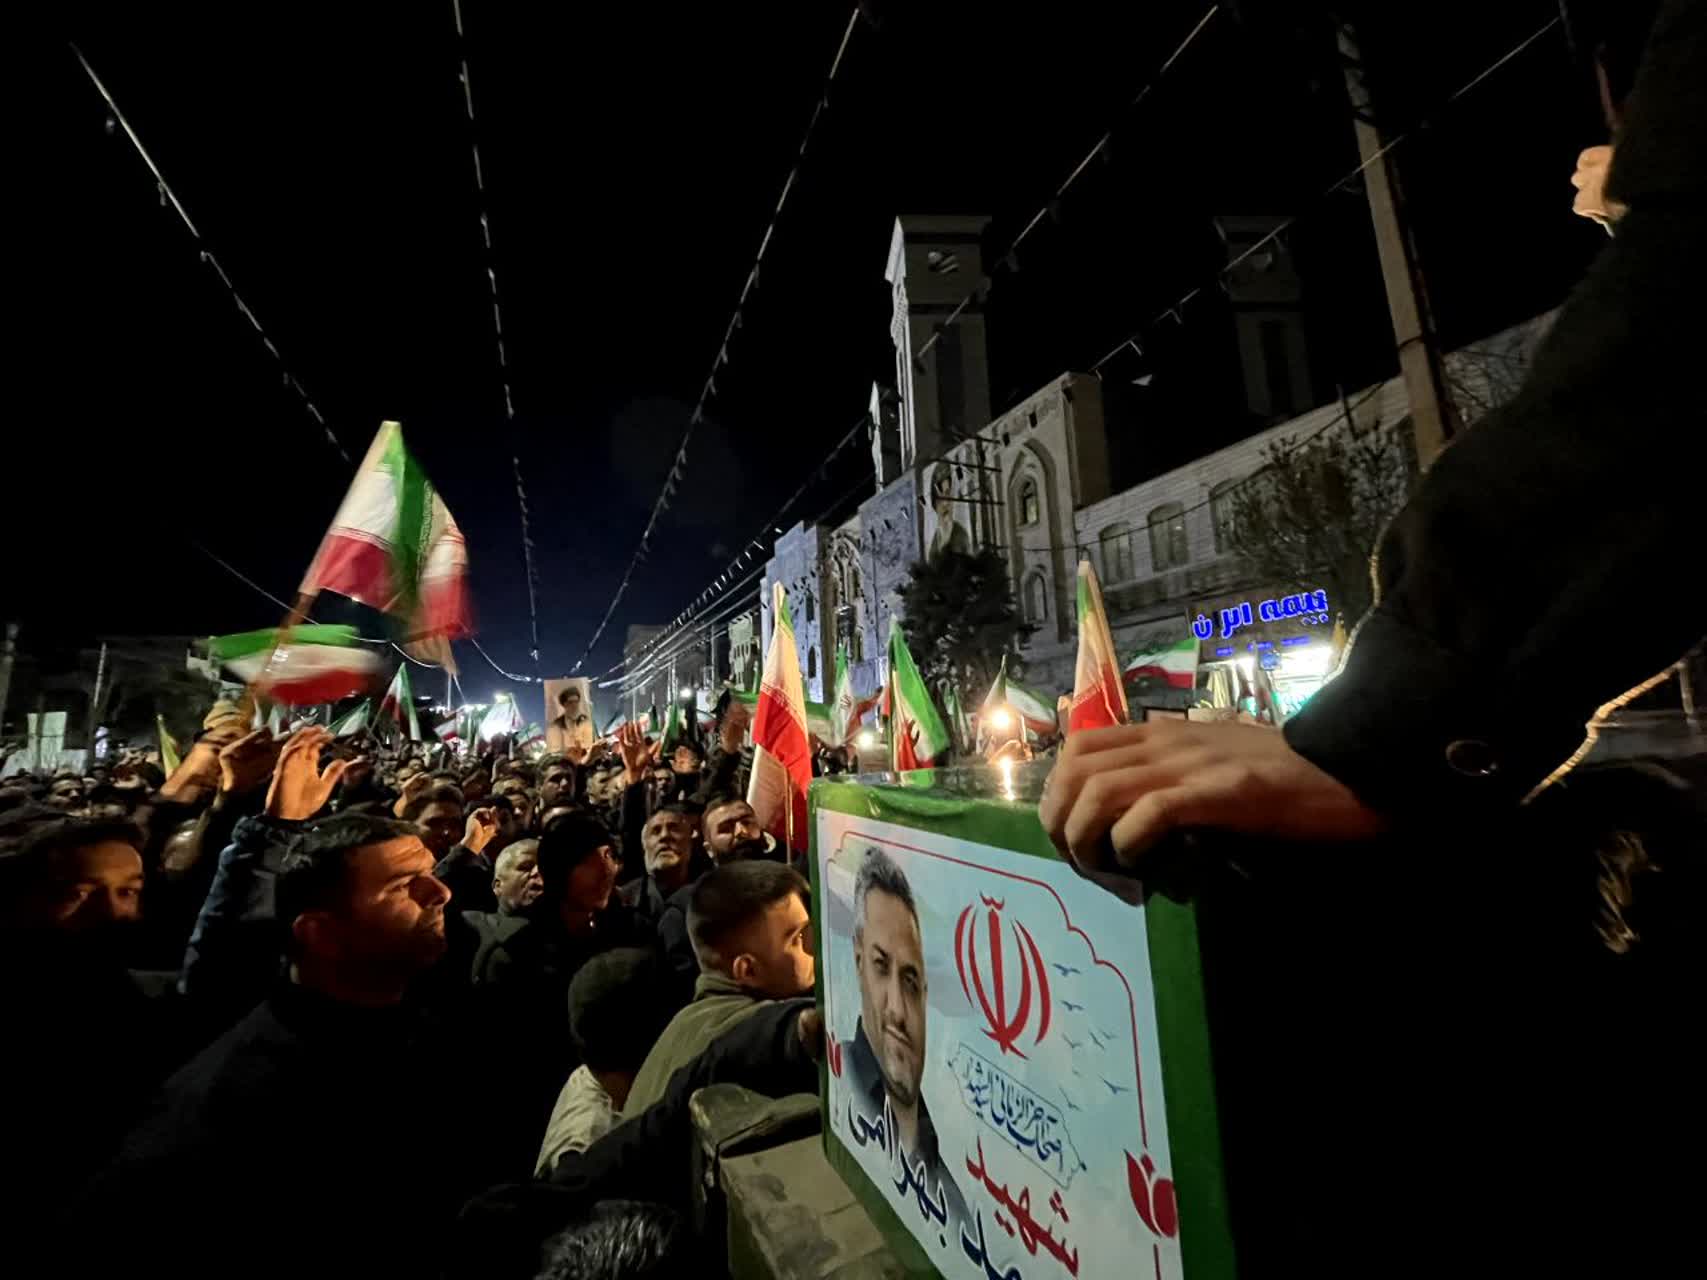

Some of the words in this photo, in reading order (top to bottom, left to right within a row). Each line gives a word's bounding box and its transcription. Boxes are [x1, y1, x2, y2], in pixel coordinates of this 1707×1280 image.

[1258, 588, 1330, 626] بیمه
[847, 1095, 949, 1248] بهرامی
[966, 1134, 1080, 1279] شهید
